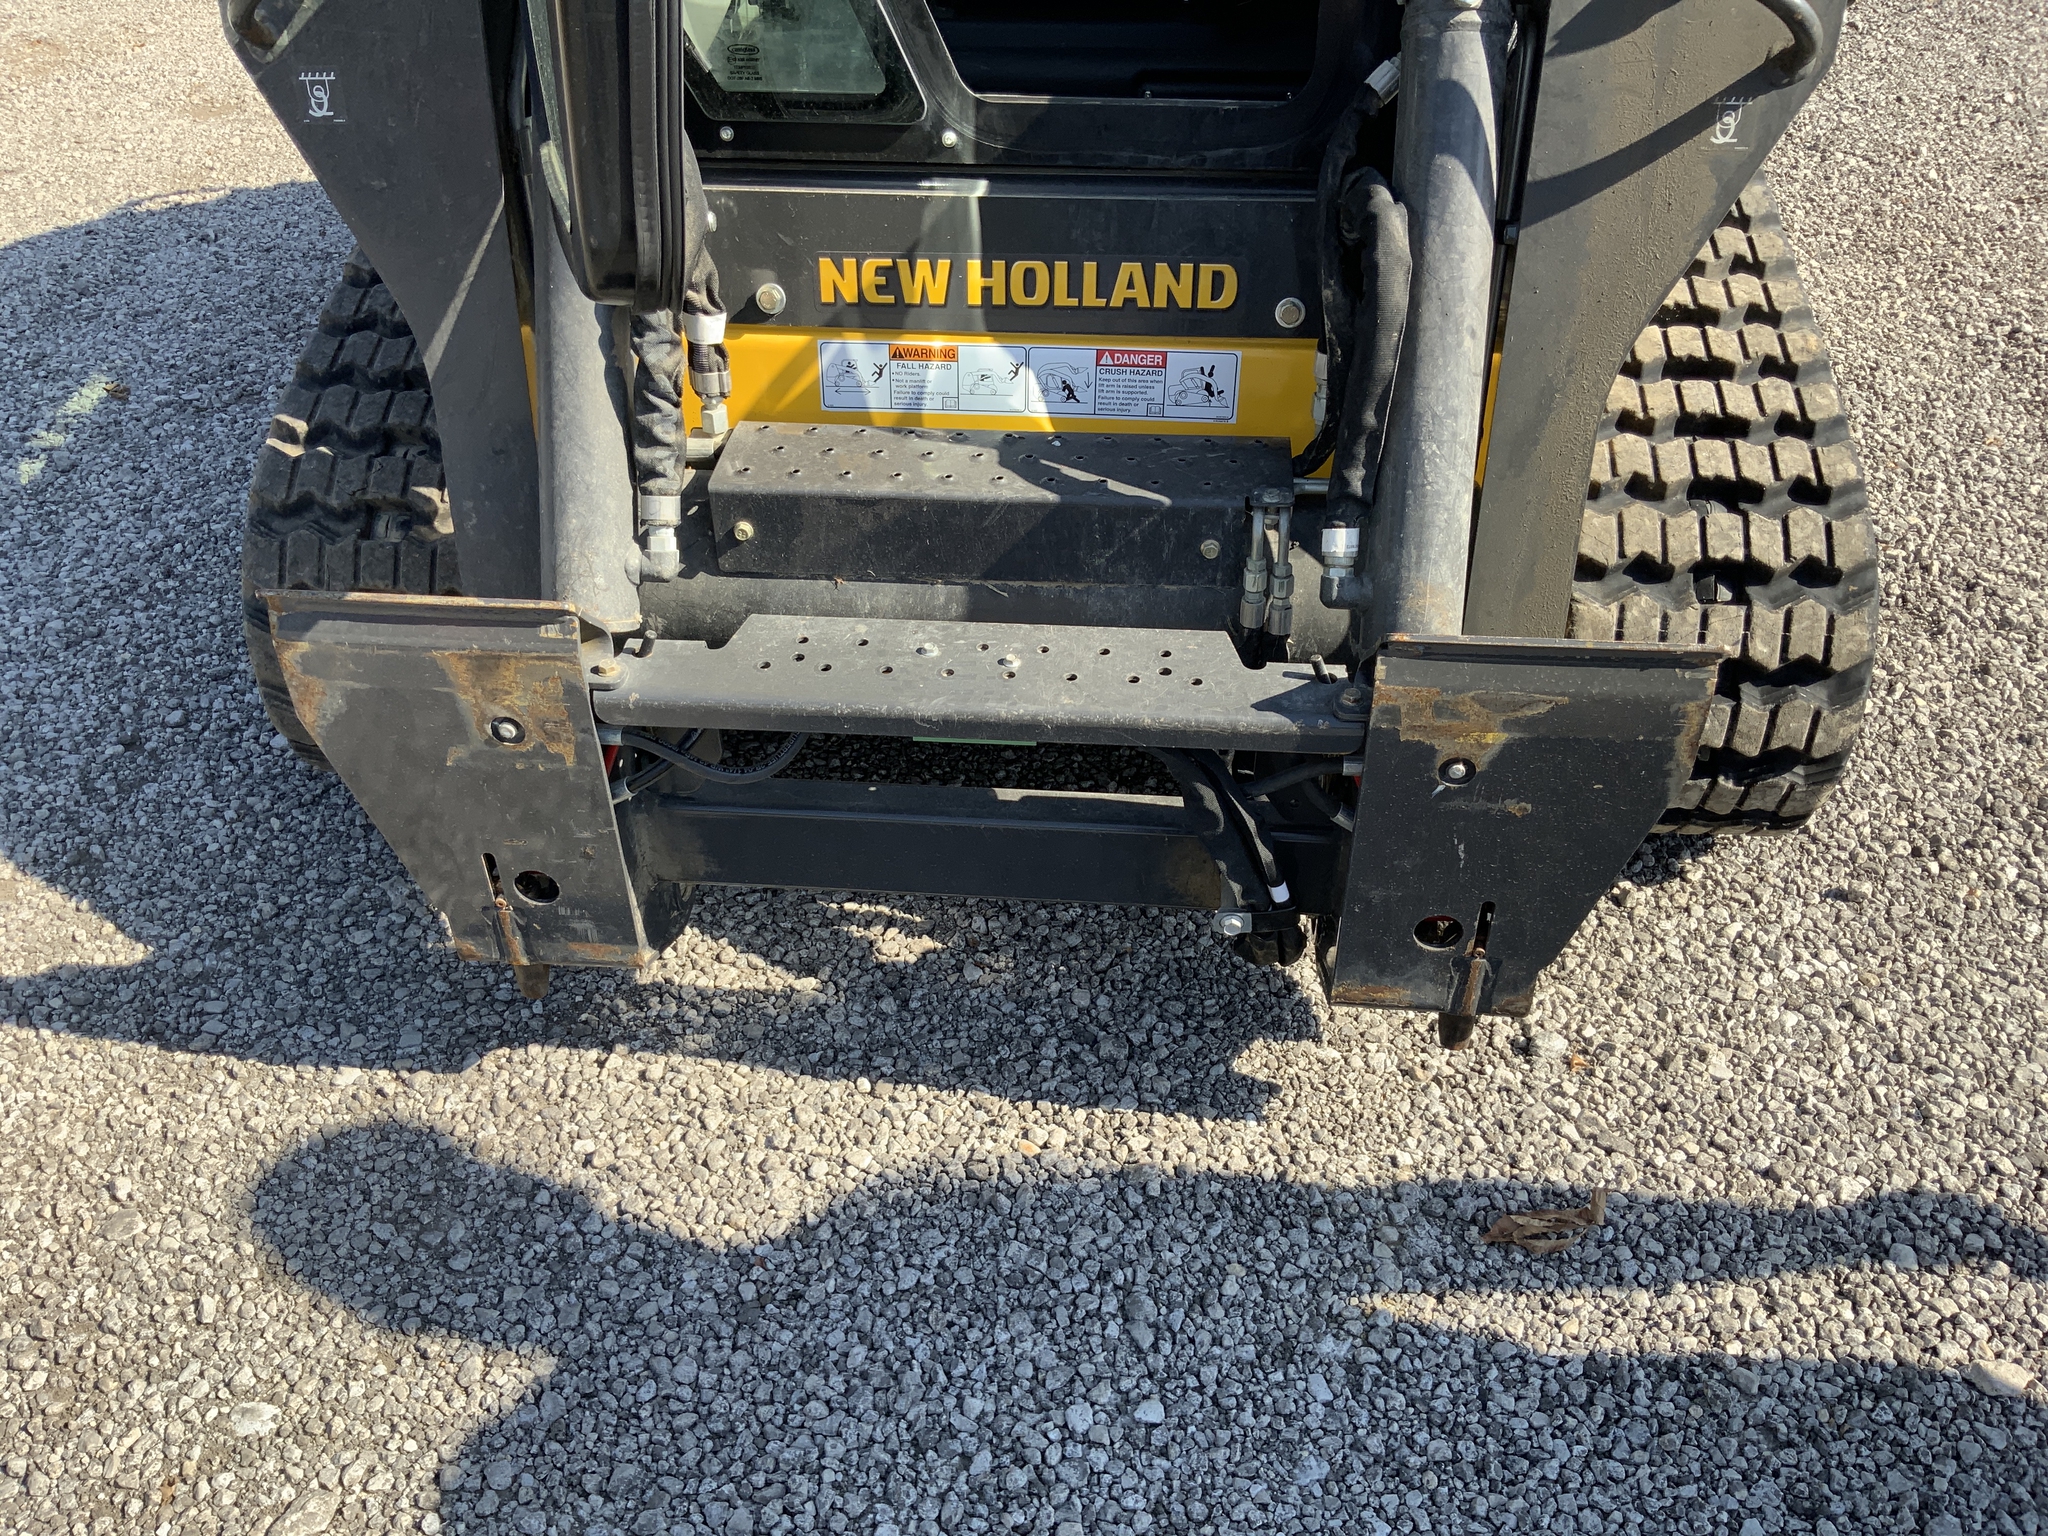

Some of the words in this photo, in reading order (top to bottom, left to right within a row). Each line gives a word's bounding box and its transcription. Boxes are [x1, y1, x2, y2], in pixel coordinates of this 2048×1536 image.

[819, 257, 951, 305] NEW
[967, 260, 1238, 309] HOLLAND
[902, 348, 956, 359] WARNING
[1114, 353, 1163, 366] DANGER
